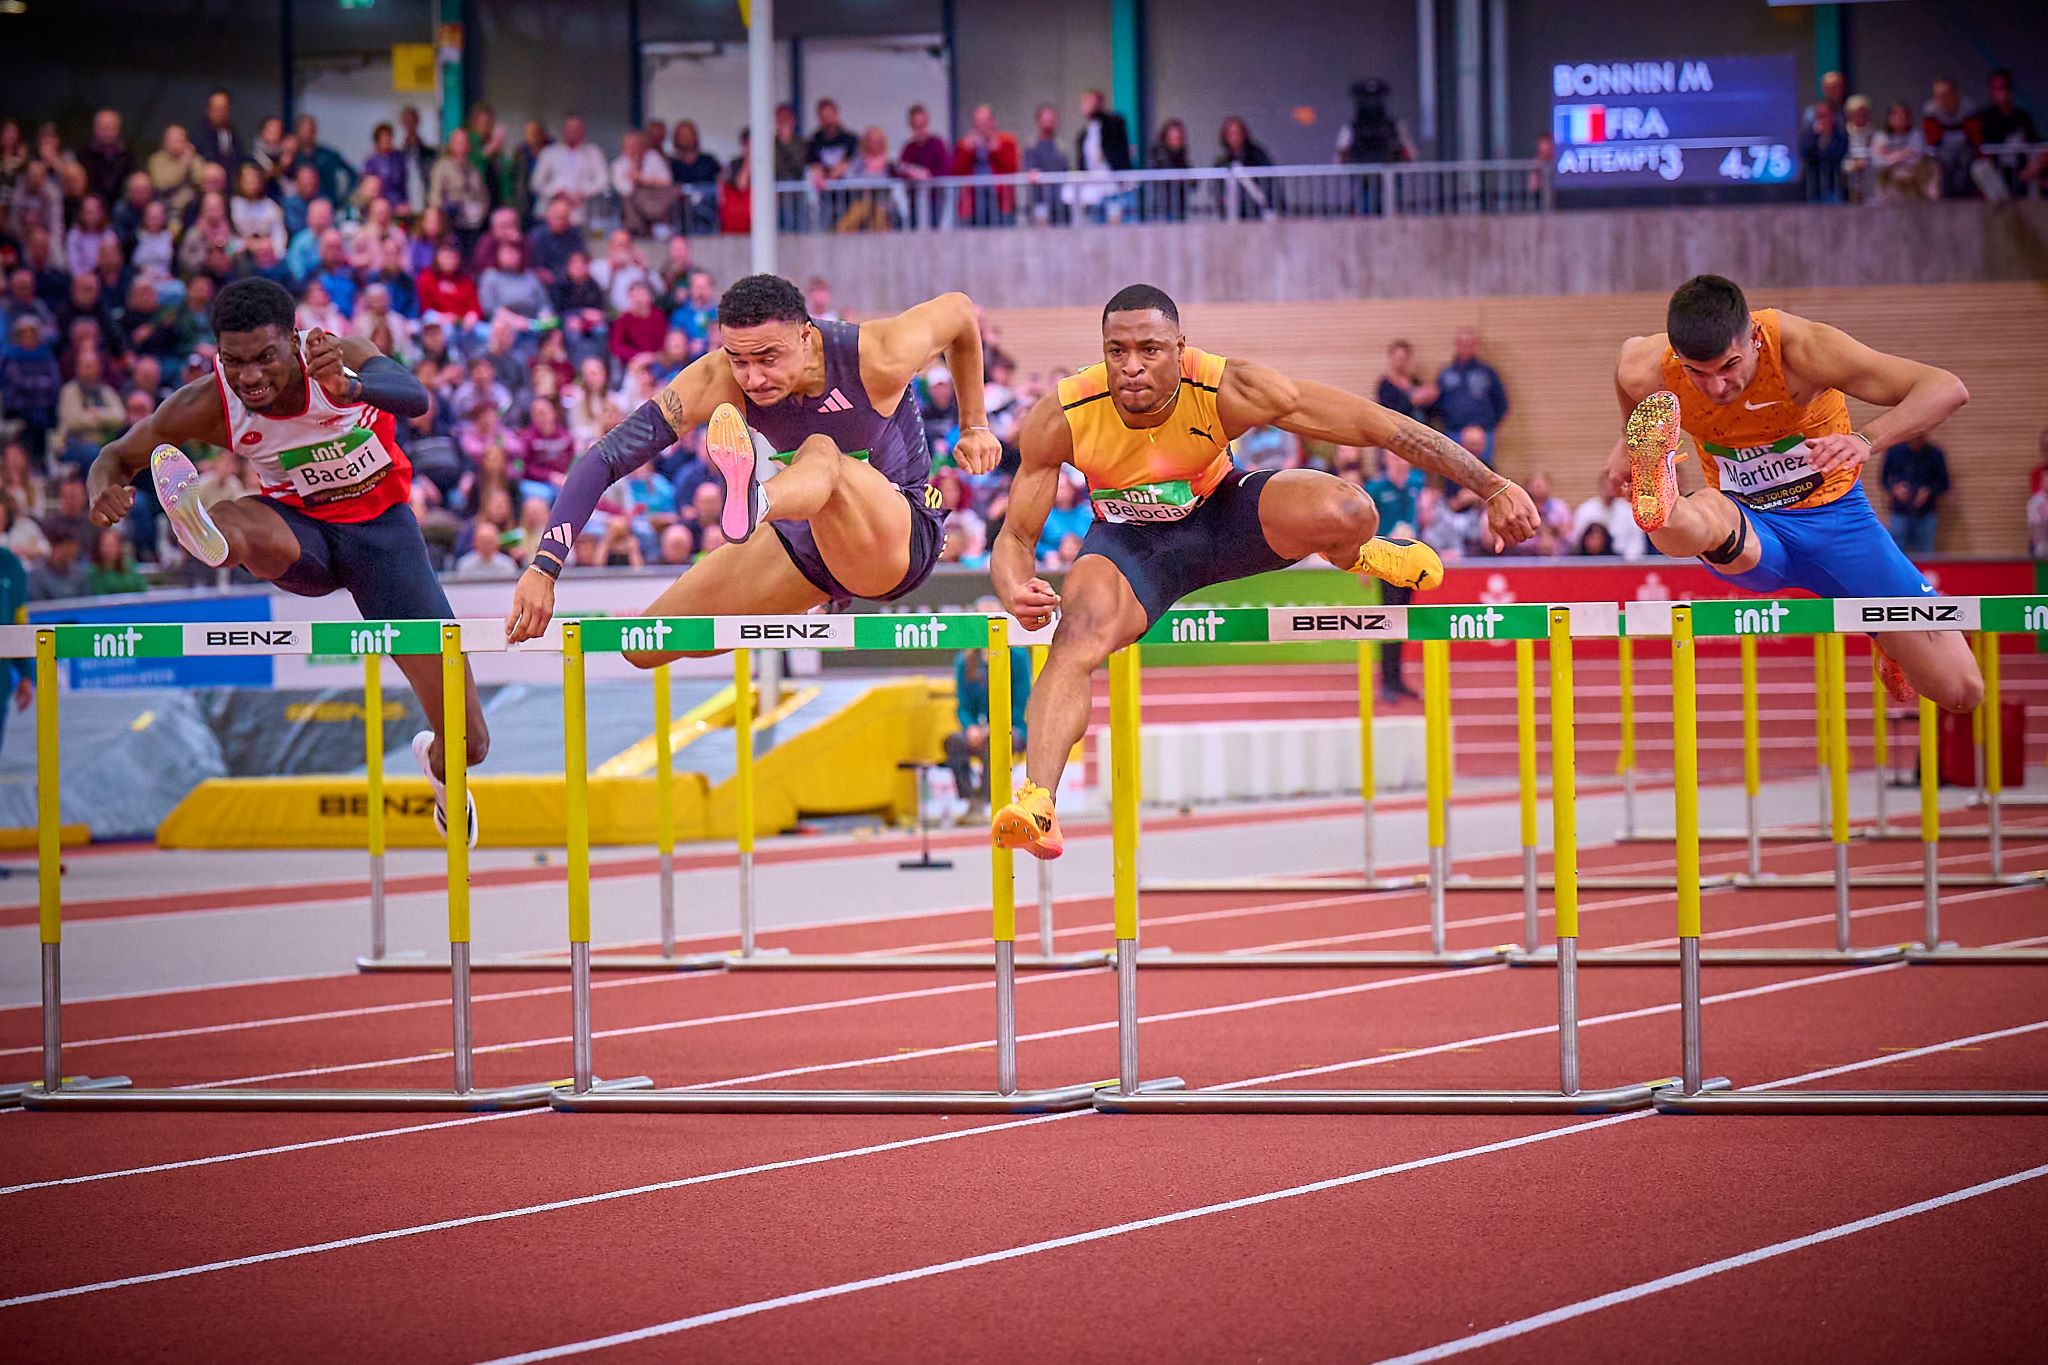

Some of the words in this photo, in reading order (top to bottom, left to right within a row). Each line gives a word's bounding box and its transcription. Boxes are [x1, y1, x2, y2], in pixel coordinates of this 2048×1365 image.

[1553, 61, 1676, 96] BONNIN
[1678, 61, 1714, 92] M
[1605, 107, 1669, 139] FRA
[1557, 146, 1660, 174] ATTEMPT
[1659, 144, 1684, 180] 3
[1719, 144, 1791, 179] 4.75
[300, 446, 376, 486] Bacari
[311, 441, 347, 462] init
[1724, 456, 1808, 487] Martinez
[1122, 485, 1163, 504] init
[1765, 489, 1788, 500] TOUR
[1789, 481, 1813, 495] GOLD
[895, 617, 947, 648] init
[1172, 611, 1225, 642] init
[1450, 607, 1504, 639] init
[1735, 601, 1789, 633] init
[2024, 605, 2048, 630] in
[94, 626, 143, 657] init
[351, 623, 400, 654] init
[621, 619, 672, 650] init
